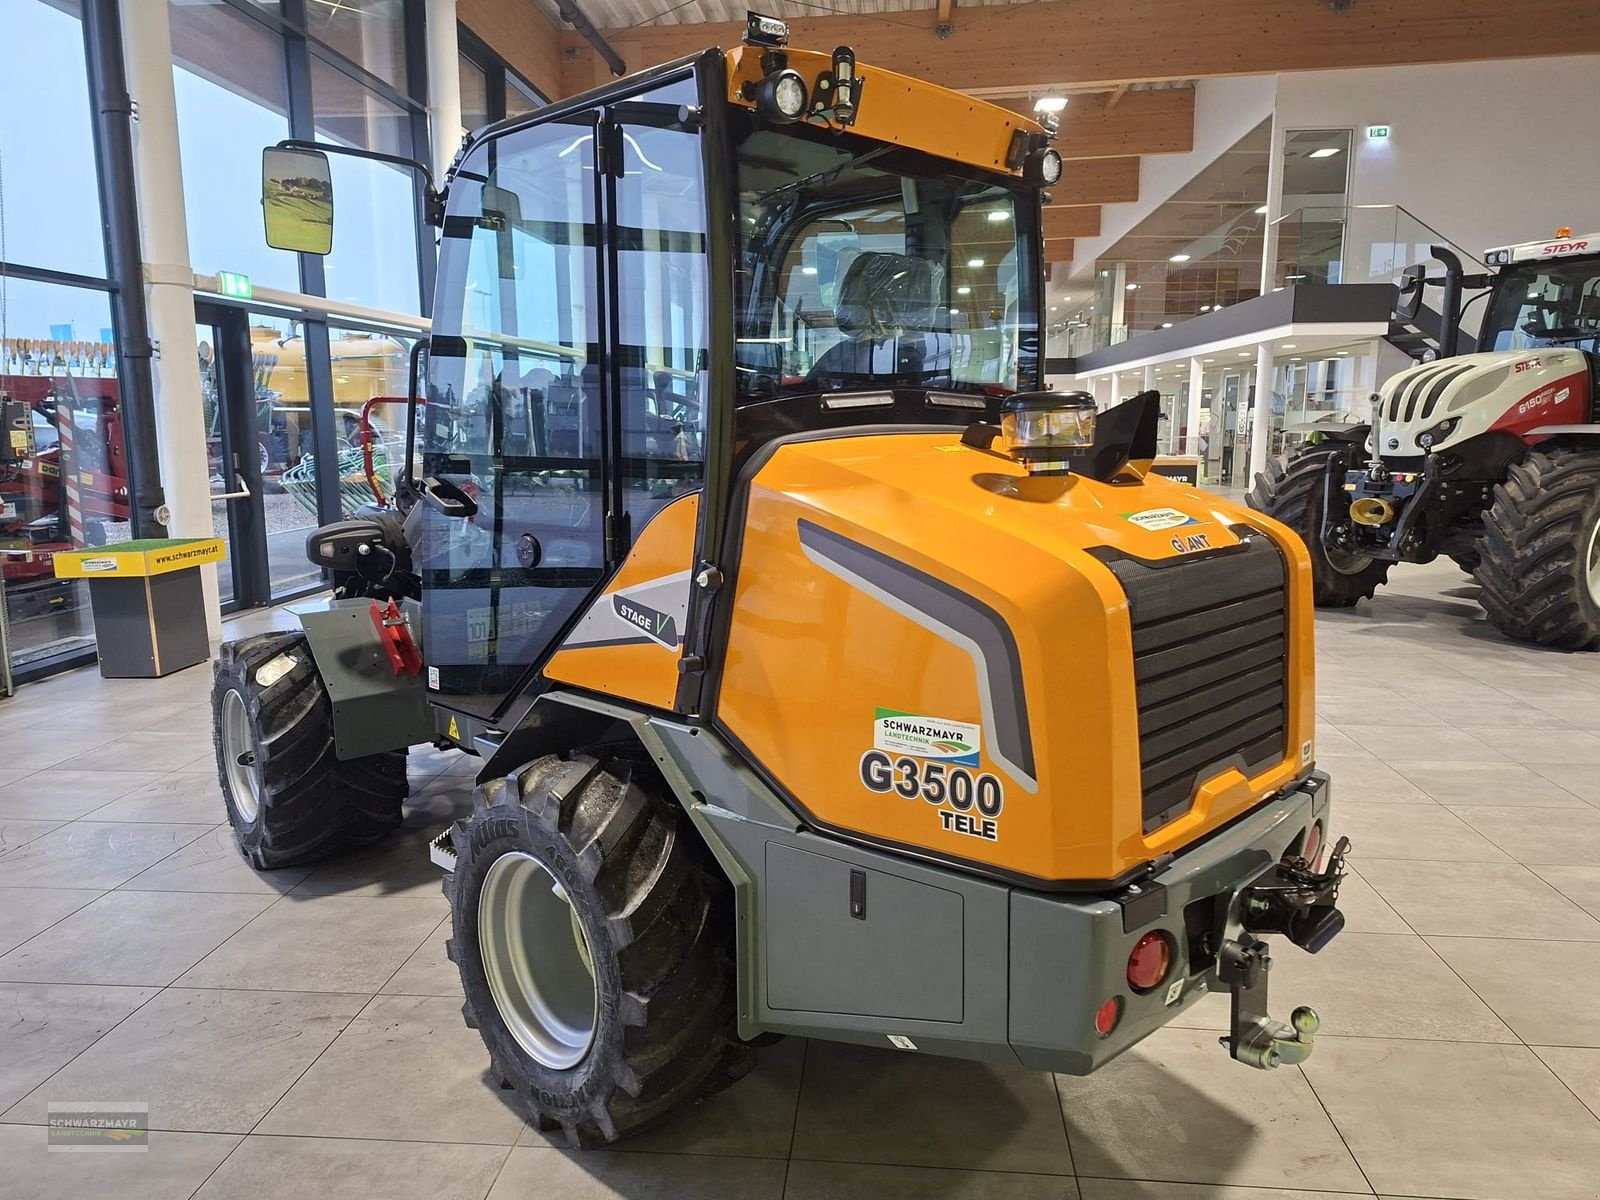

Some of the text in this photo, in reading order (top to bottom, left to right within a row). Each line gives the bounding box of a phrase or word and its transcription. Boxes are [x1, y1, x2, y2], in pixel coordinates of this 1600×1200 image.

[1542, 241, 1588, 255] STEYR
[1519, 395, 1541, 414] 6150
[1171, 533, 1211, 553] GIANT
[155, 545, 218, 564] www.schwarzmayr.at
[620, 605, 671, 635] STAGE V
[883, 719, 964, 742] SCHWARZMAYR
[884, 730, 930, 745] LANDTECHNIK
[861, 751, 1002, 817] G3500
[940, 810, 997, 840] TELE
